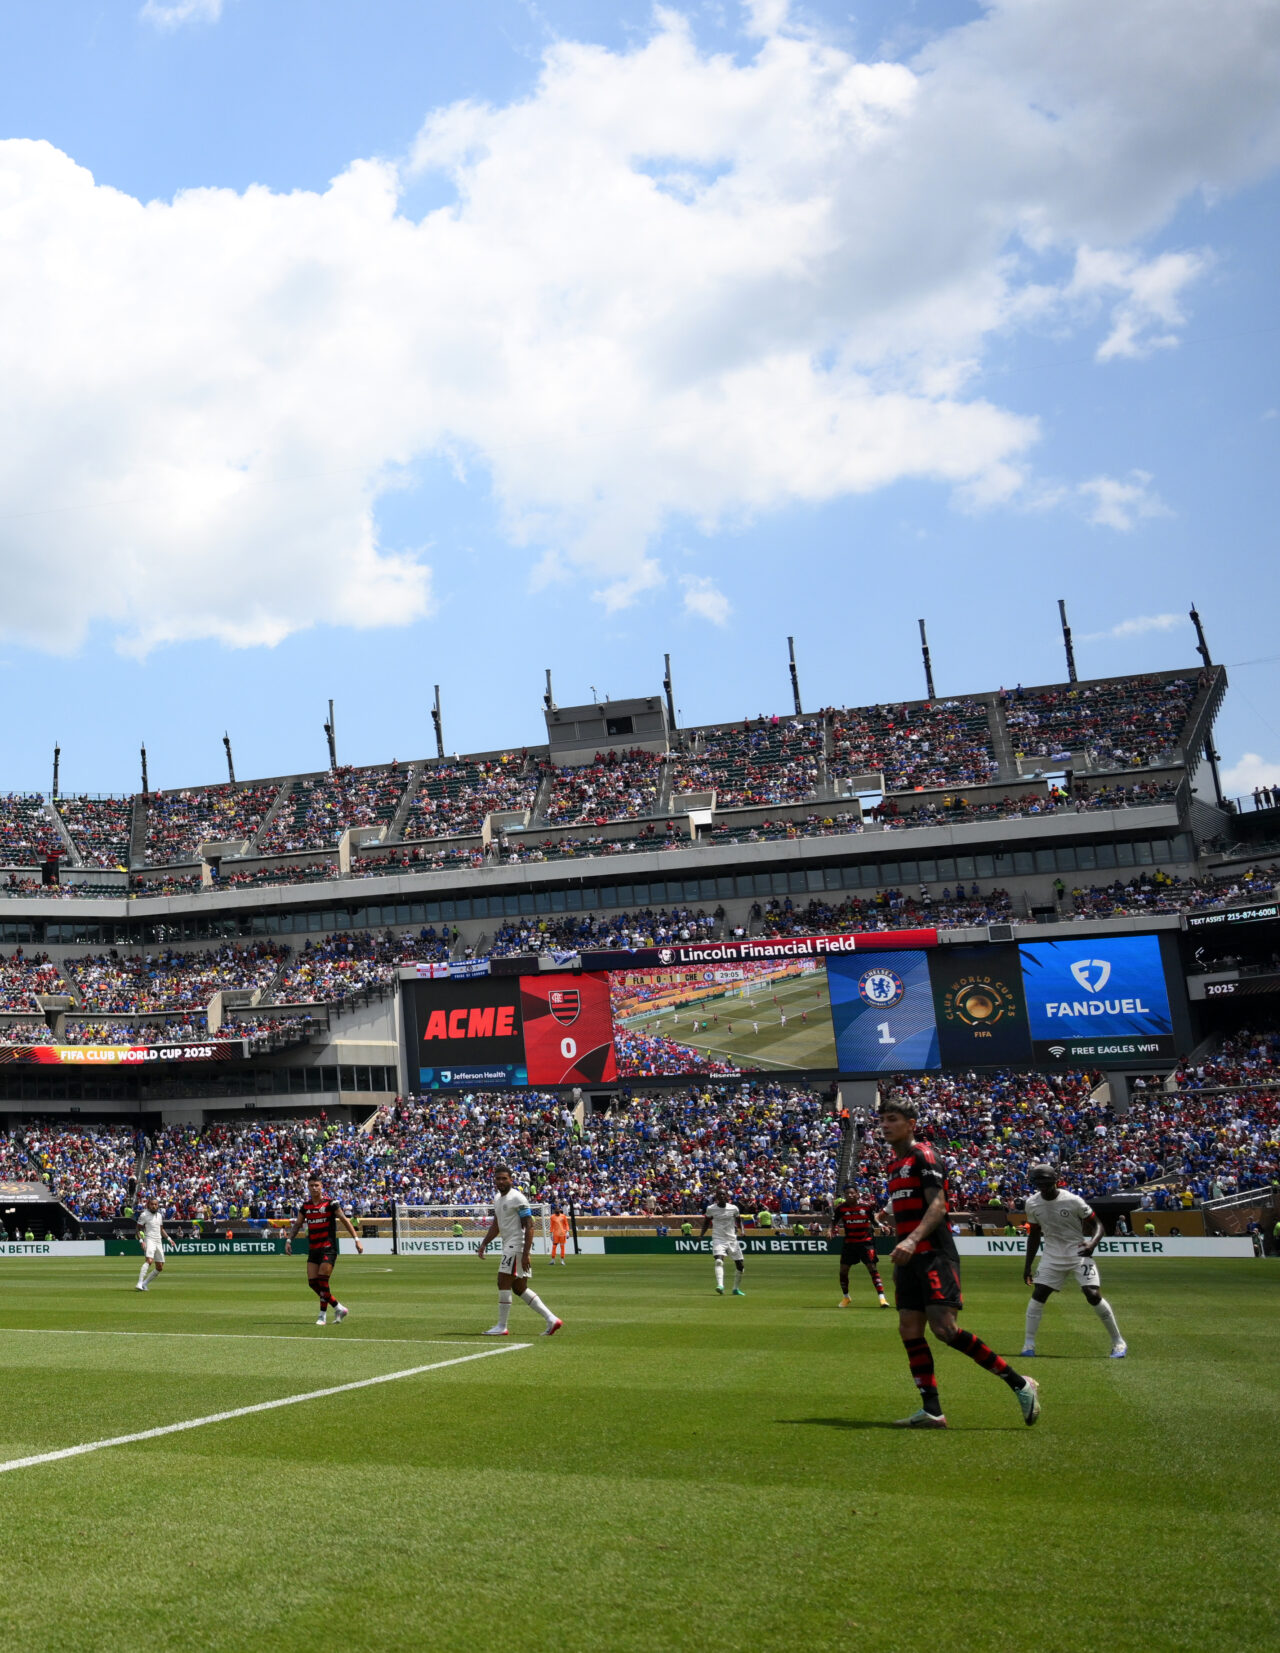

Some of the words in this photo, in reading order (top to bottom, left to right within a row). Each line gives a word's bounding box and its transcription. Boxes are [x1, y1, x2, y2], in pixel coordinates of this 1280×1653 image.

[1190, 917, 1205, 925] TEXT
[1206, 915, 1226, 923] ASSIST
[680, 945, 737, 962] Lincoln
[740, 940, 812, 958] Financial
[815, 937, 856, 952] Field
[864, 969, 893, 979] CHELSEA
[633, 977, 645, 985] FLA
[944, 994, 954, 1020] CLUB
[951, 976, 990, 990] WORLD
[995, 982, 1013, 1000] CUP
[1008, 1004, 1016, 1017] 25
[1046, 998, 1149, 1017] FANDUEL
[877, 1022, 895, 1044] 1
[561, 1037, 577, 1058] 0
[1071, 1046, 1095, 1055] FREE
[1097, 1045, 1135, 1054] EAGLES
[1137, 1043, 1159, 1052] WIFI
[61, 1050, 85, 1060] FIFA
[86, 1050, 115, 1060] CLUB
[117, 1049, 158, 1060] WORLD
[159, 1048, 182, 1059] CUP
[453, 1072, 483, 1080] Jefferson
[484, 1071, 506, 1079] Health
[8, 1244, 50, 1253] BETTER
[163, 1243, 216, 1252] INVESTED
[219, 1243, 230, 1252] IN
[233, 1243, 275, 1252] BETTER
[401, 1241, 464, 1251] INVESTED
[468, 1241, 480, 1251] IN
[751, 1240, 766, 1251] IN
[770, 1240, 828, 1251] BETTER
[1098, 1241, 1163, 1252] BETTER
[502, 1255, 513, 1267] 24
[1081, 1264, 1096, 1276] 25
